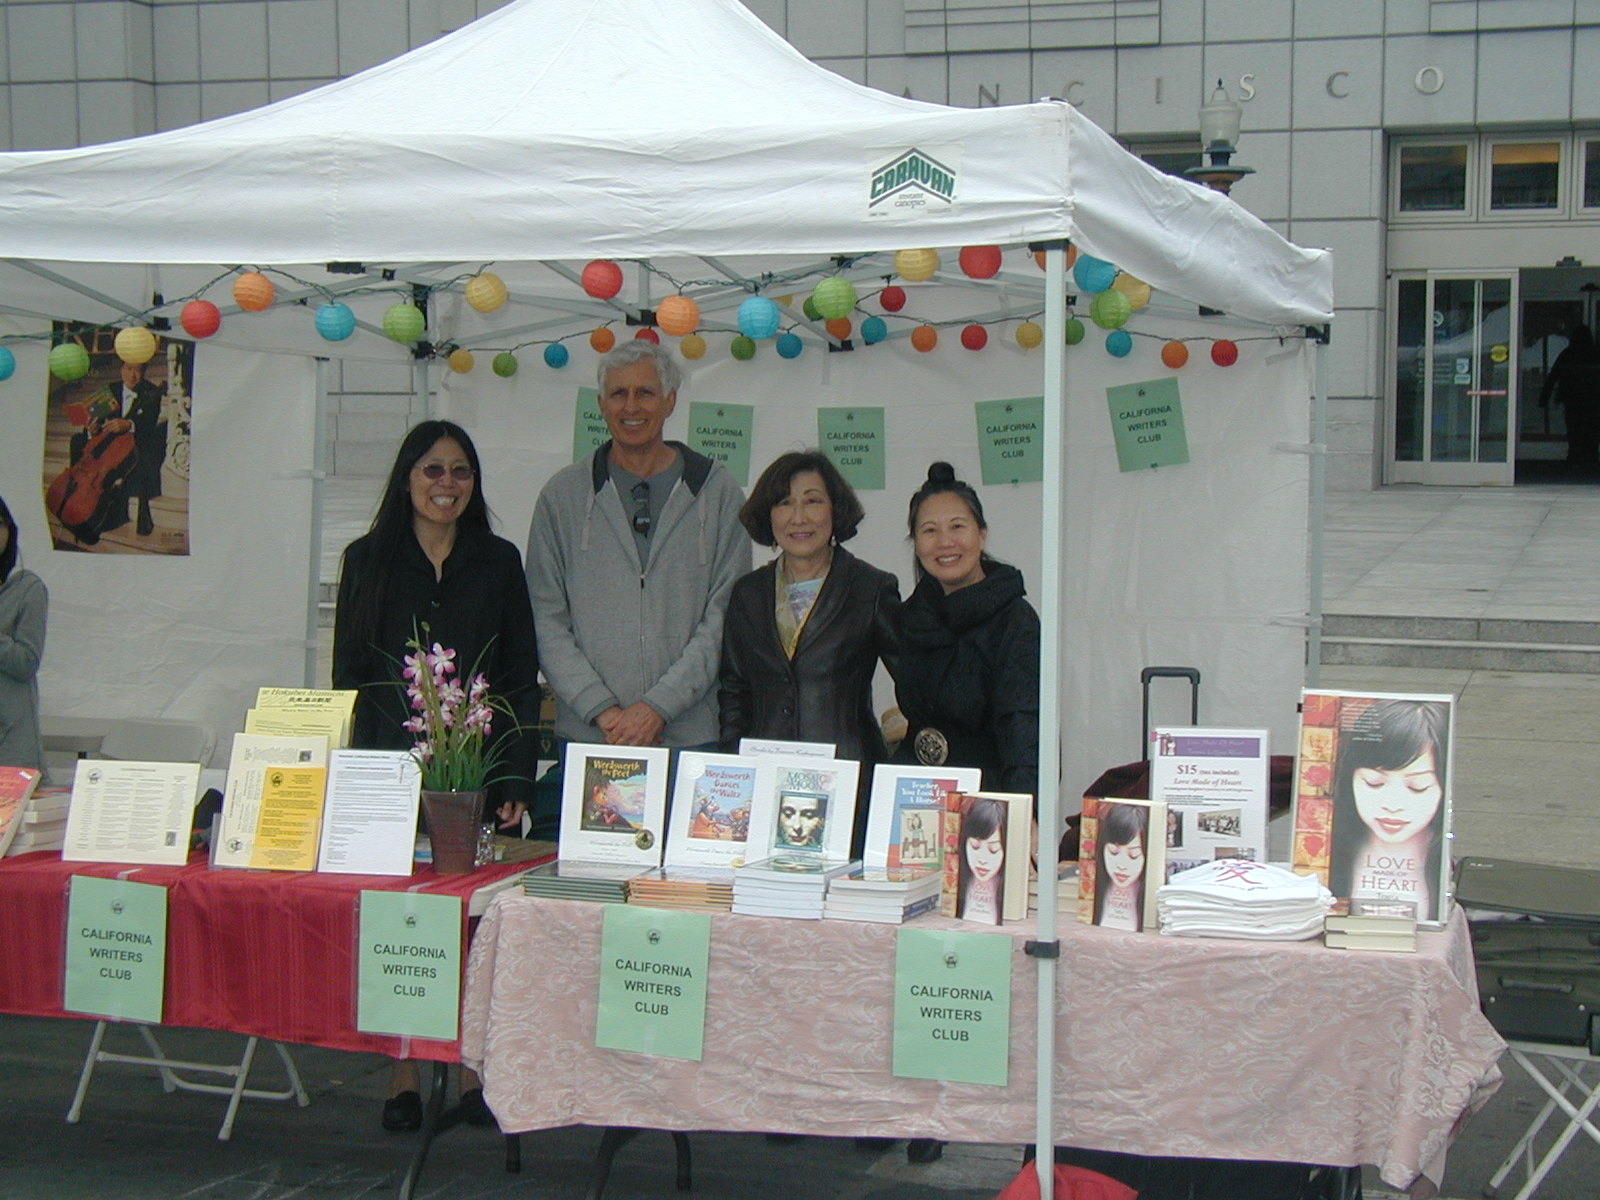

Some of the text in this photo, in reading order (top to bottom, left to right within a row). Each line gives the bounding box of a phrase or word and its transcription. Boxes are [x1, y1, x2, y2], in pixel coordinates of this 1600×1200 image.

[870, 154, 955, 200] CARAVAN
[1119, 405, 1173, 421] CALIFORNIA
[696, 427, 743, 437] CALIFORNIA
[986, 422, 1037, 434] CALIFORNIA
[1127, 419, 1168, 433] WRITERS
[826, 431, 876, 441] CALIFORNIA
[993, 436, 1031, 447] WRITERS
[1137, 433, 1162, 444] CLUB
[701, 440, 737, 450] WRITERS
[833, 444, 870, 453] WRITERS
[840, 457, 863, 466] CLUB
[1001, 450, 1025, 459] CLUB
[593, 760, 641, 770] Wordsworth
[1177, 764, 1198, 775] $15
[611, 769, 631, 778] Poet
[704, 769, 751, 780] Wordsworth
[714, 780, 740, 789] Dances
[720, 789, 742, 798] Waltz
[1366, 854, 1416, 871] LOVE
[1361, 875, 1419, 892] HEART
[81, 927, 153, 946] CALIFORNIA
[89, 947, 144, 963] WRITERS
[373, 943, 447, 960] CALIFORNIA
[99, 967, 132, 981] CLUB
[382, 963, 437, 979] WRITERS
[615, 958, 693, 979] CALIFORNIA
[393, 984, 426, 998] CLUB
[624, 979, 682, 998] WRITERS
[910, 984, 994, 1002] CALIFORNIA
[634, 1001, 669, 1016] CLUB
[920, 1005, 982, 1022] WRITERS
[931, 1028, 969, 1043] CLUB
